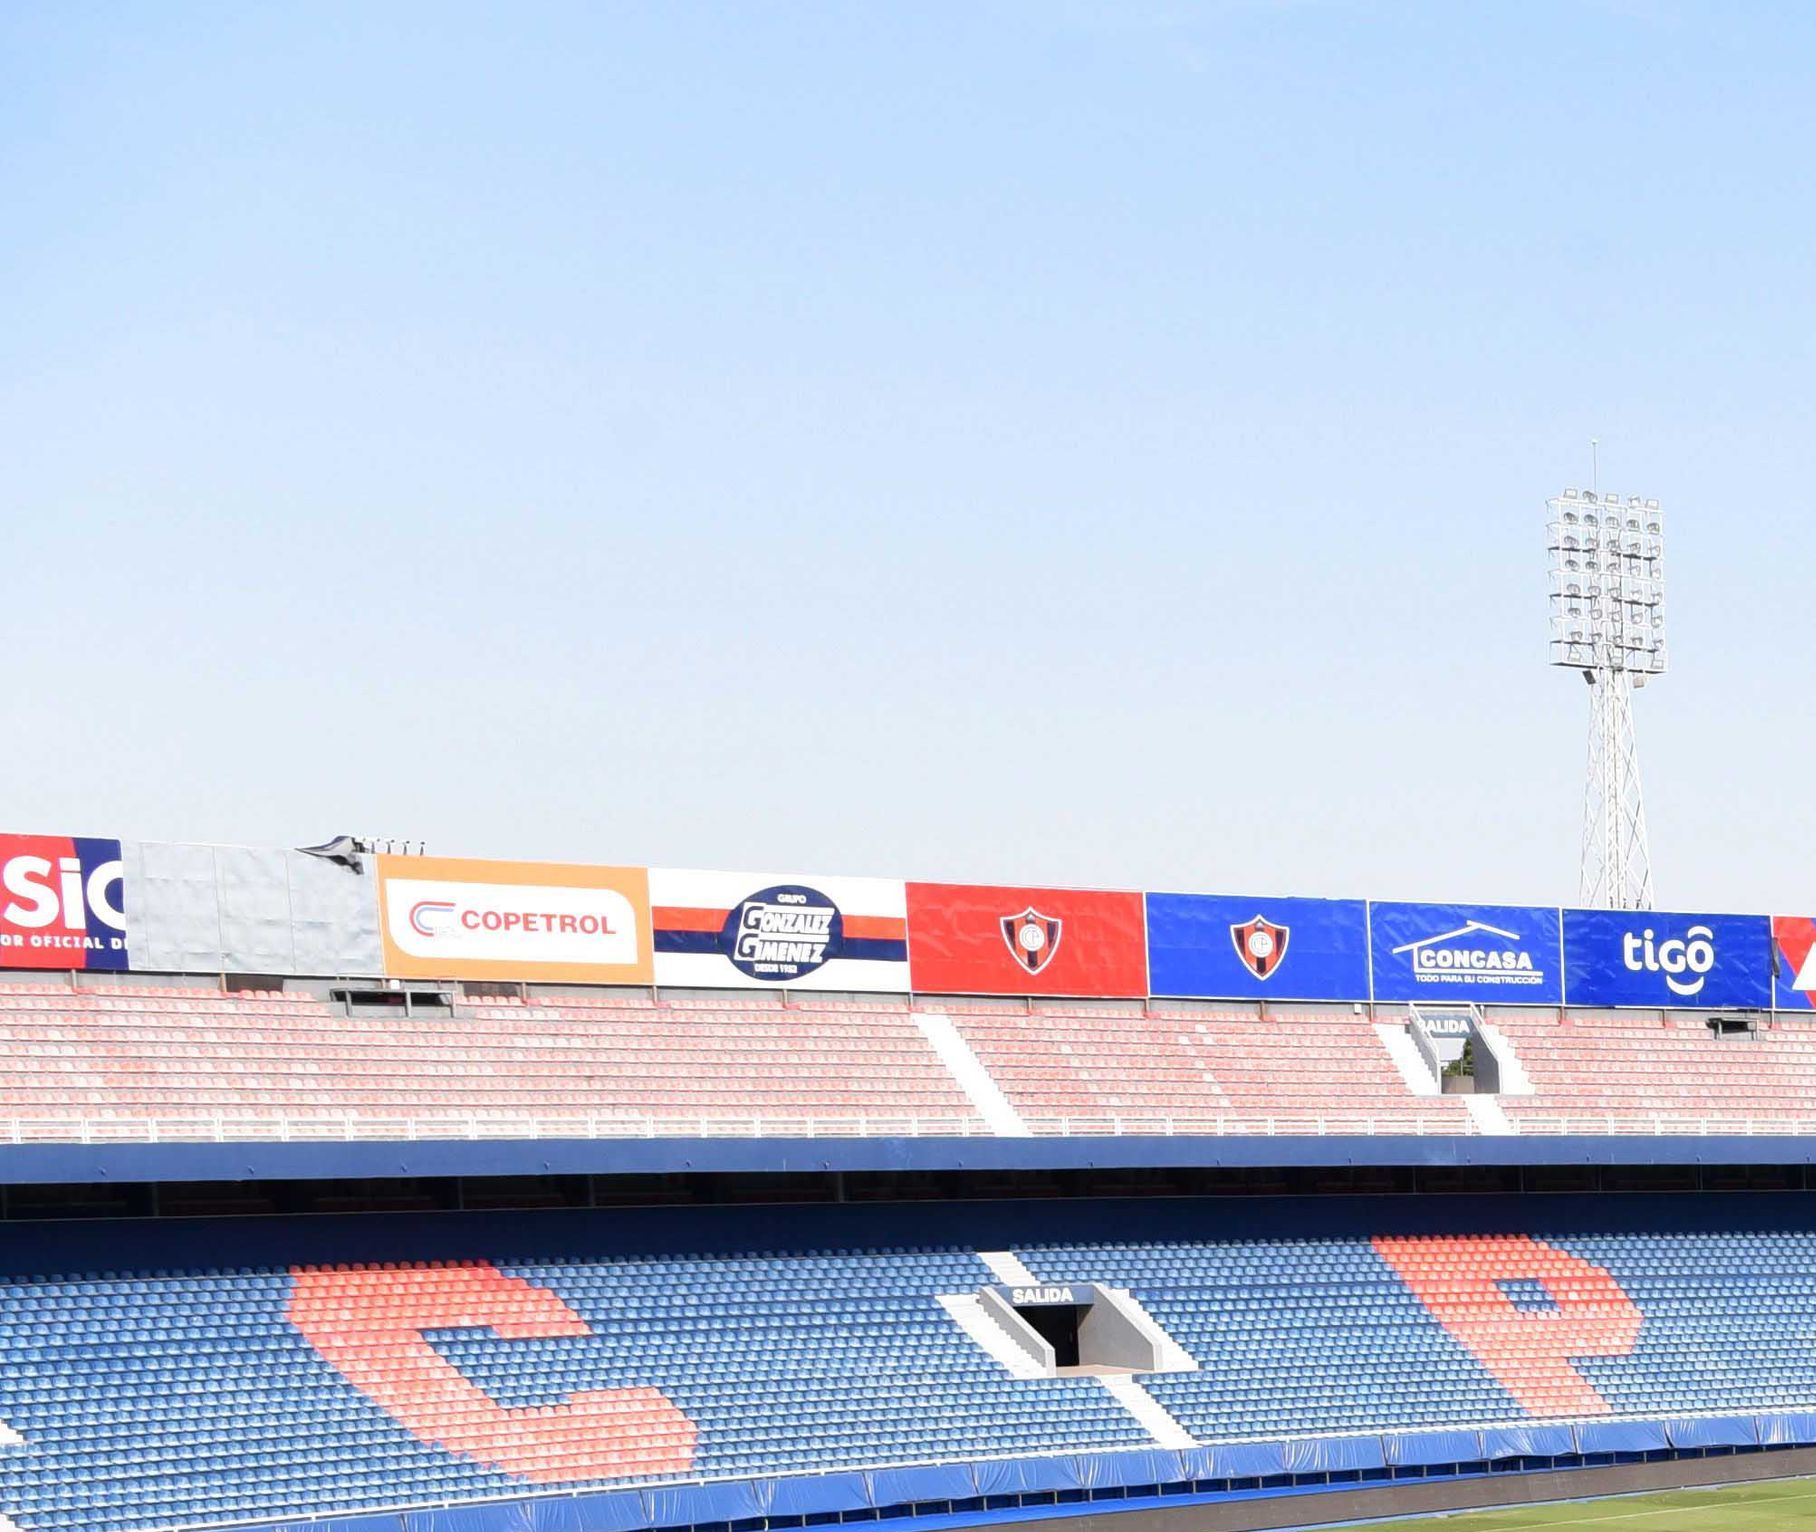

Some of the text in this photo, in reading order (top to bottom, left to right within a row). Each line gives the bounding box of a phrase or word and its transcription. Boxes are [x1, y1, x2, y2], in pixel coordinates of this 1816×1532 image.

[461, 909, 616, 935] COPETROL
[30, 935, 104, 949] OFICIAL
[1420, 949, 1533, 970] CONCASA
[1416, 974, 1439, 983] TODO
[1012, 1287, 1074, 1304] SALIDA
[286, 1234, 1644, 1482] C P
